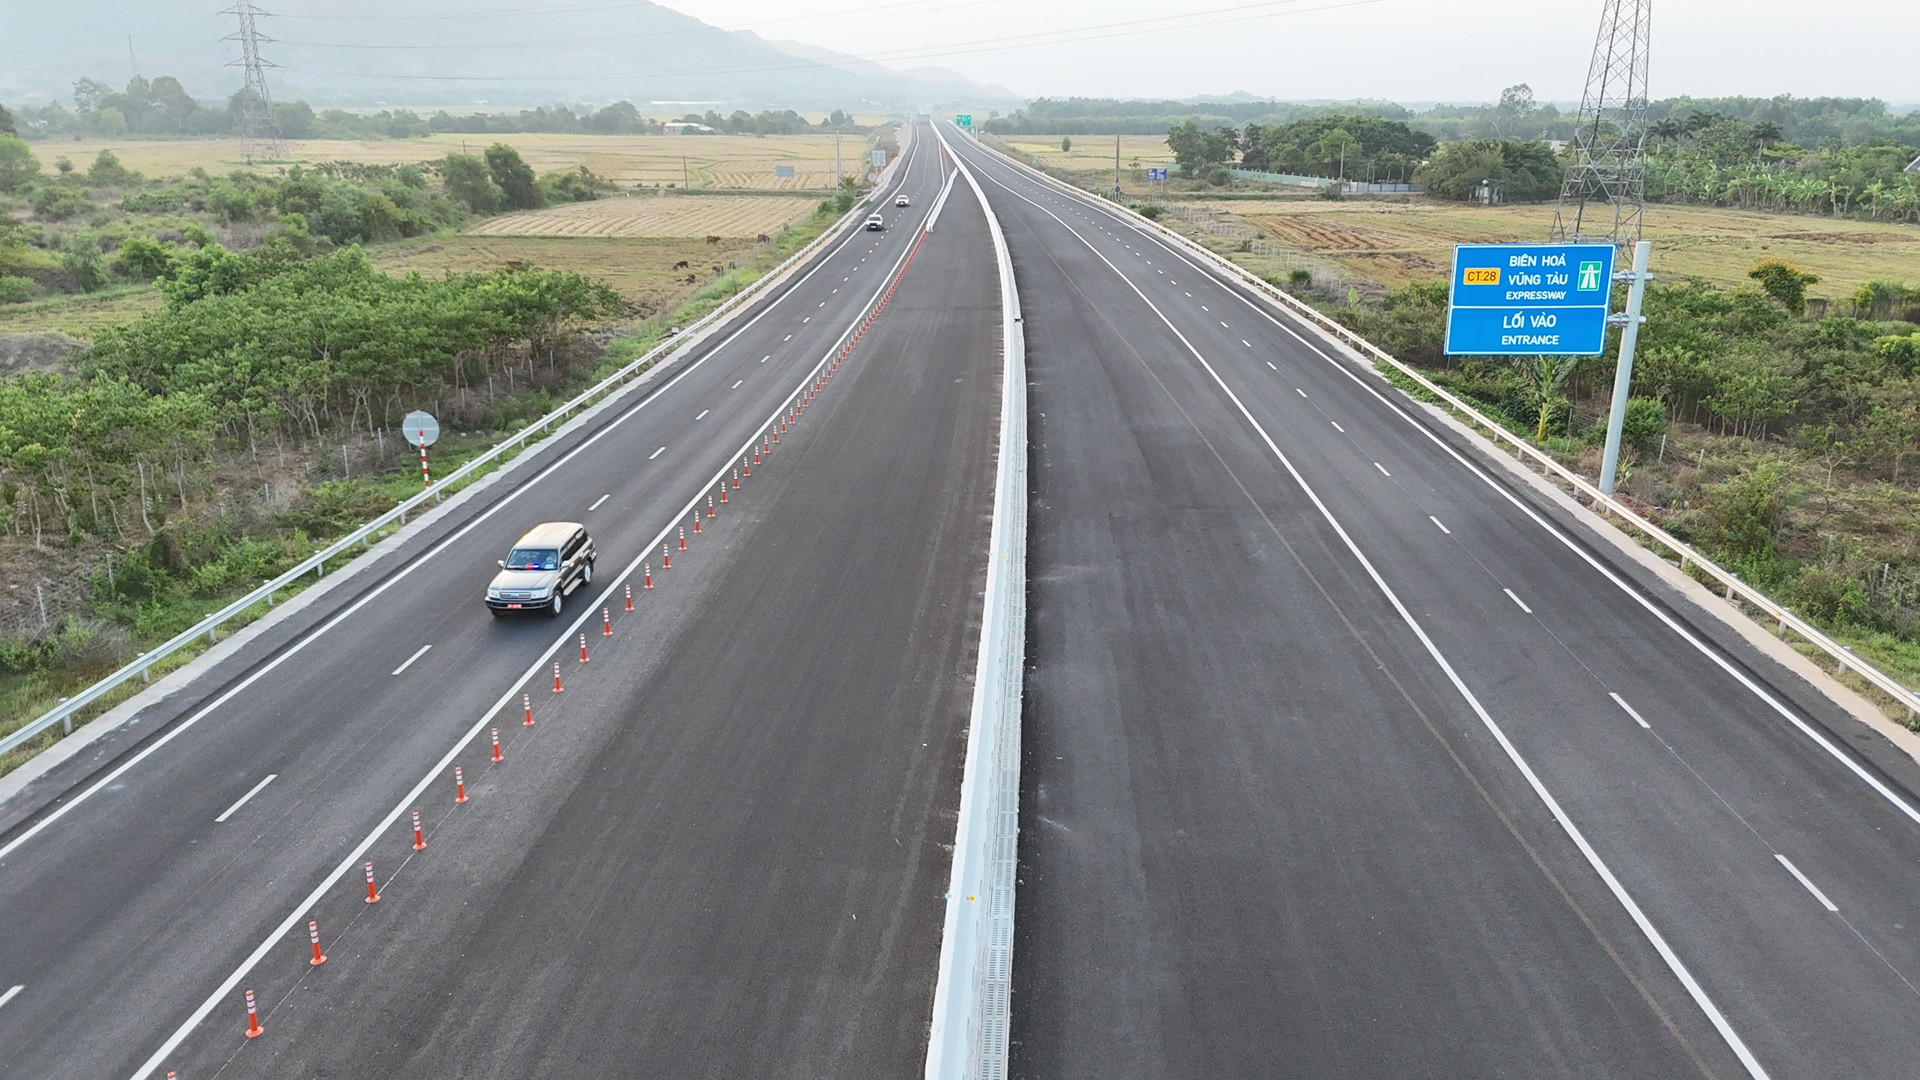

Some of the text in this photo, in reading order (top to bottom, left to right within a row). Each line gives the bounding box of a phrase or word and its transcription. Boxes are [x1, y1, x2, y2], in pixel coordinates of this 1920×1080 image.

[1509, 254, 1537, 267] BIÊN
[1467, 271, 1497, 282] CT.28
[1508, 271, 1569, 286] VŨNG TÀU
[1505, 291, 1567, 300] EXPRESSWAY
[1503, 311, 1557, 329] LỐI VÀO
[1501, 335, 1560, 345] ENTRANCE
